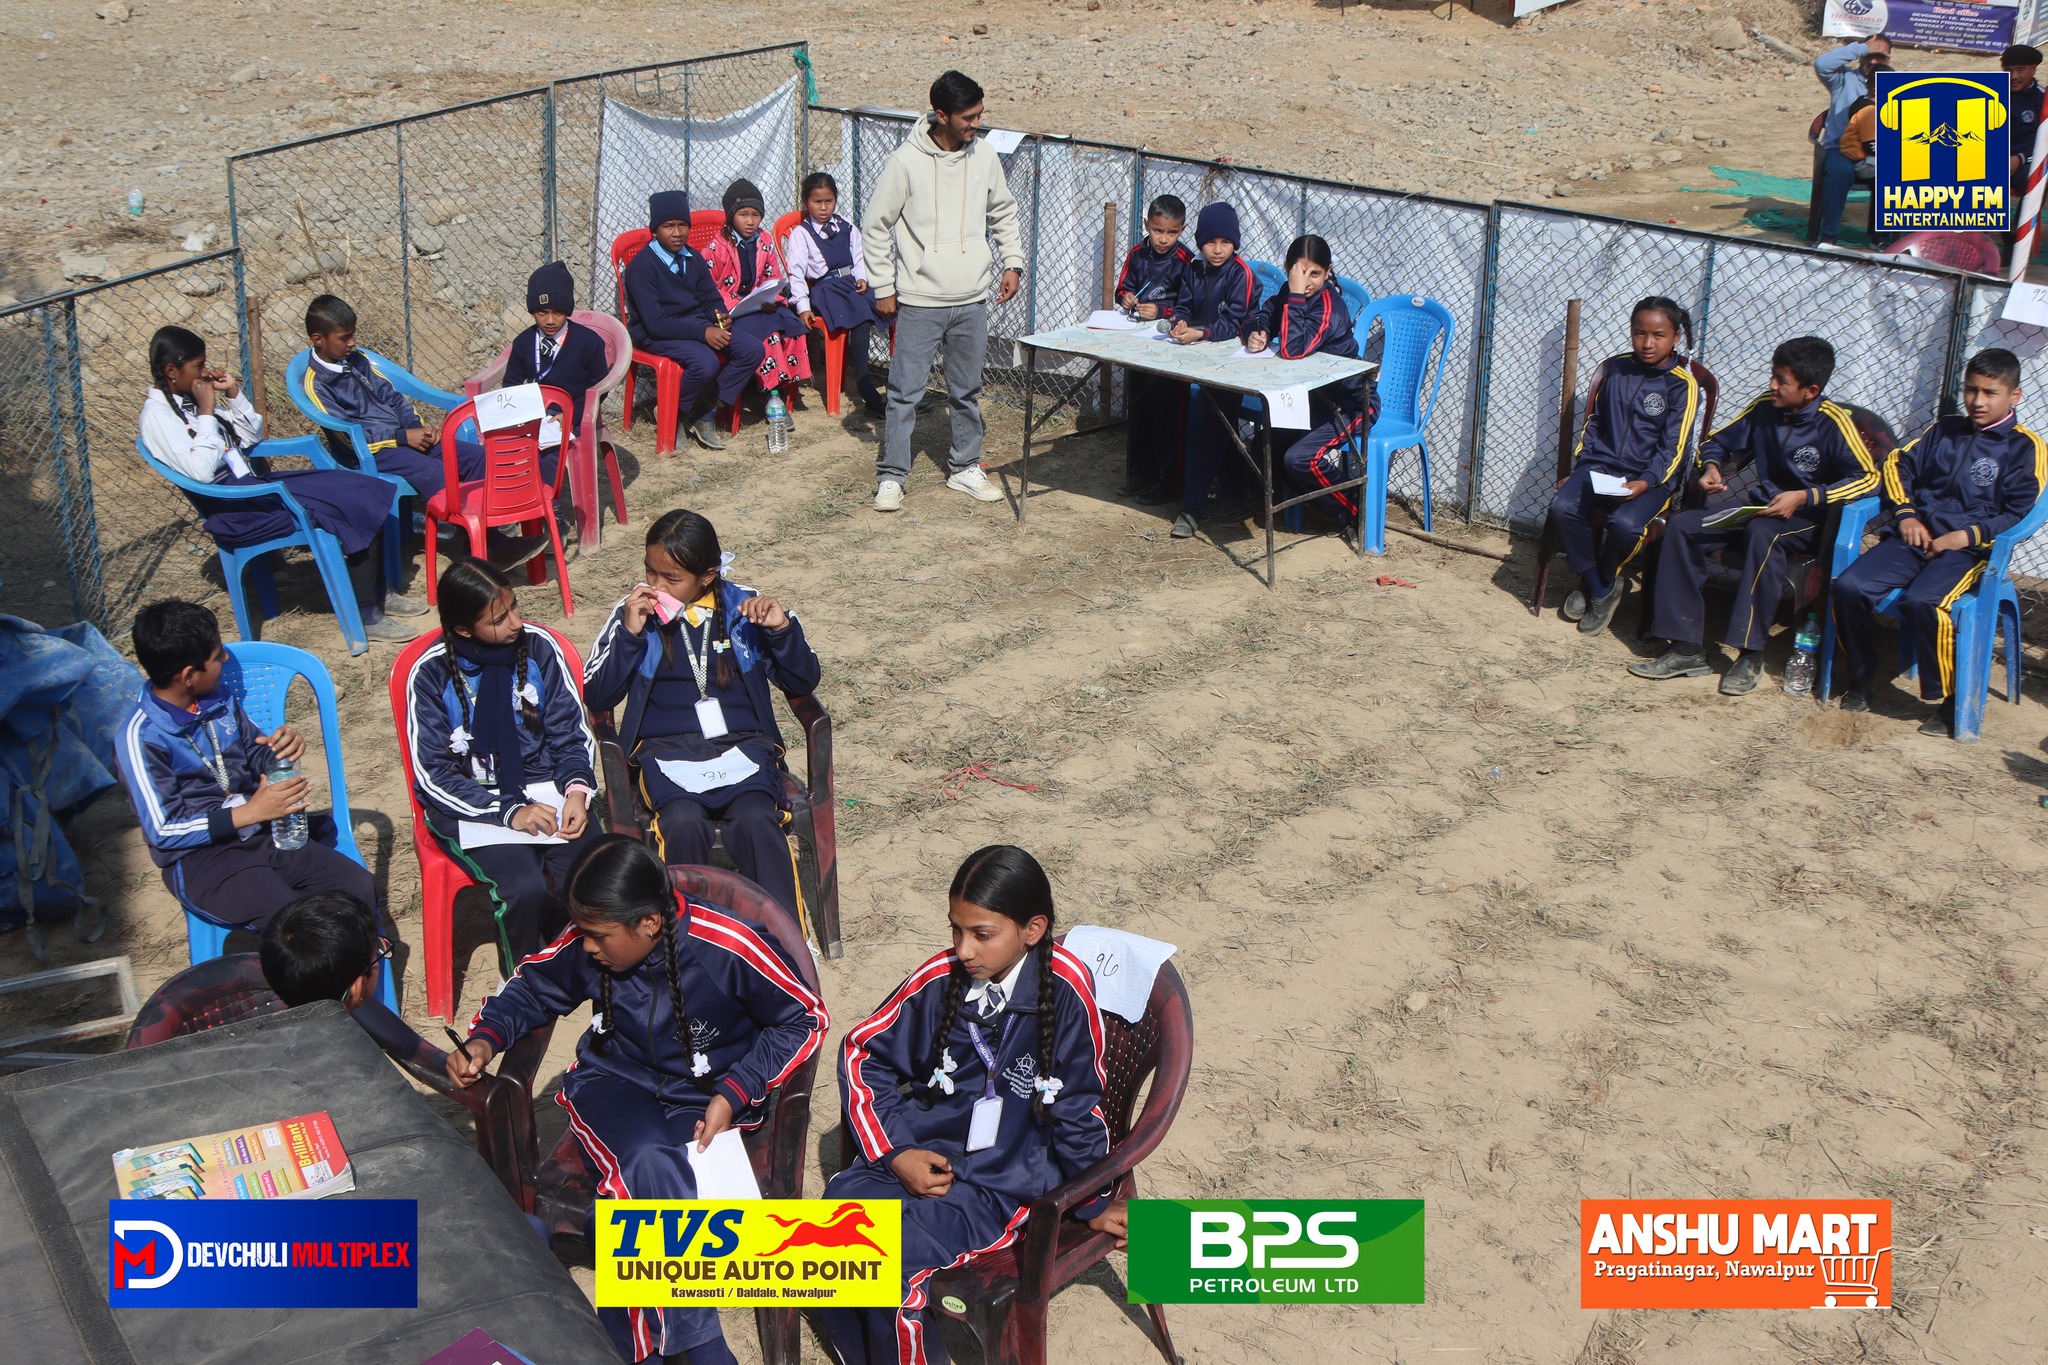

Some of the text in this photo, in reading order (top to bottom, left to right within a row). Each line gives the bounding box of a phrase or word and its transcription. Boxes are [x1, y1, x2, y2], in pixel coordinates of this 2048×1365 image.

[1933, 7, 1956, 15] Head
[286, 1123, 312, 1167] Brilliant
[944, 1300, 963, 1310] United
